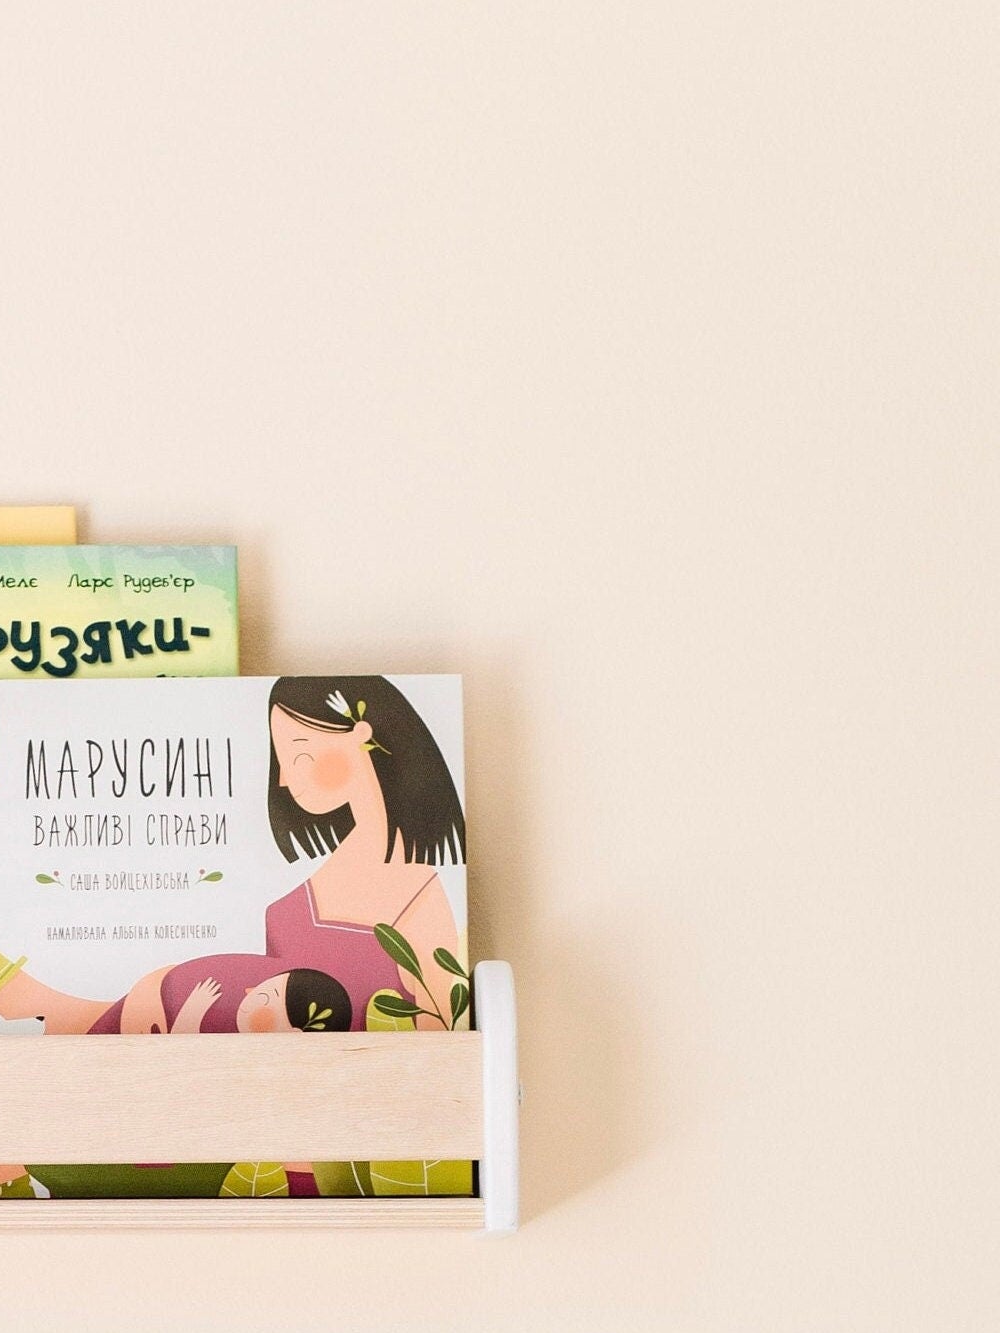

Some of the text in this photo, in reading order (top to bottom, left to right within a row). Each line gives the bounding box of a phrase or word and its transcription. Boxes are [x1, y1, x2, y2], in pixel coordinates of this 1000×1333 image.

[67, 573, 114, 593] Ларс
[25, 737, 233, 800] МАРУСИНІ
[32, 813, 228, 847] ВАЖЛИВІ СПРАВИ
[70, 871, 190, 893] САША ВОЙЦЕХІВСЬКА
[47, 924, 217, 941] НАМАЛЮВАЛА АЛЬБІНА КОЛЕСНІЧЕНКО
